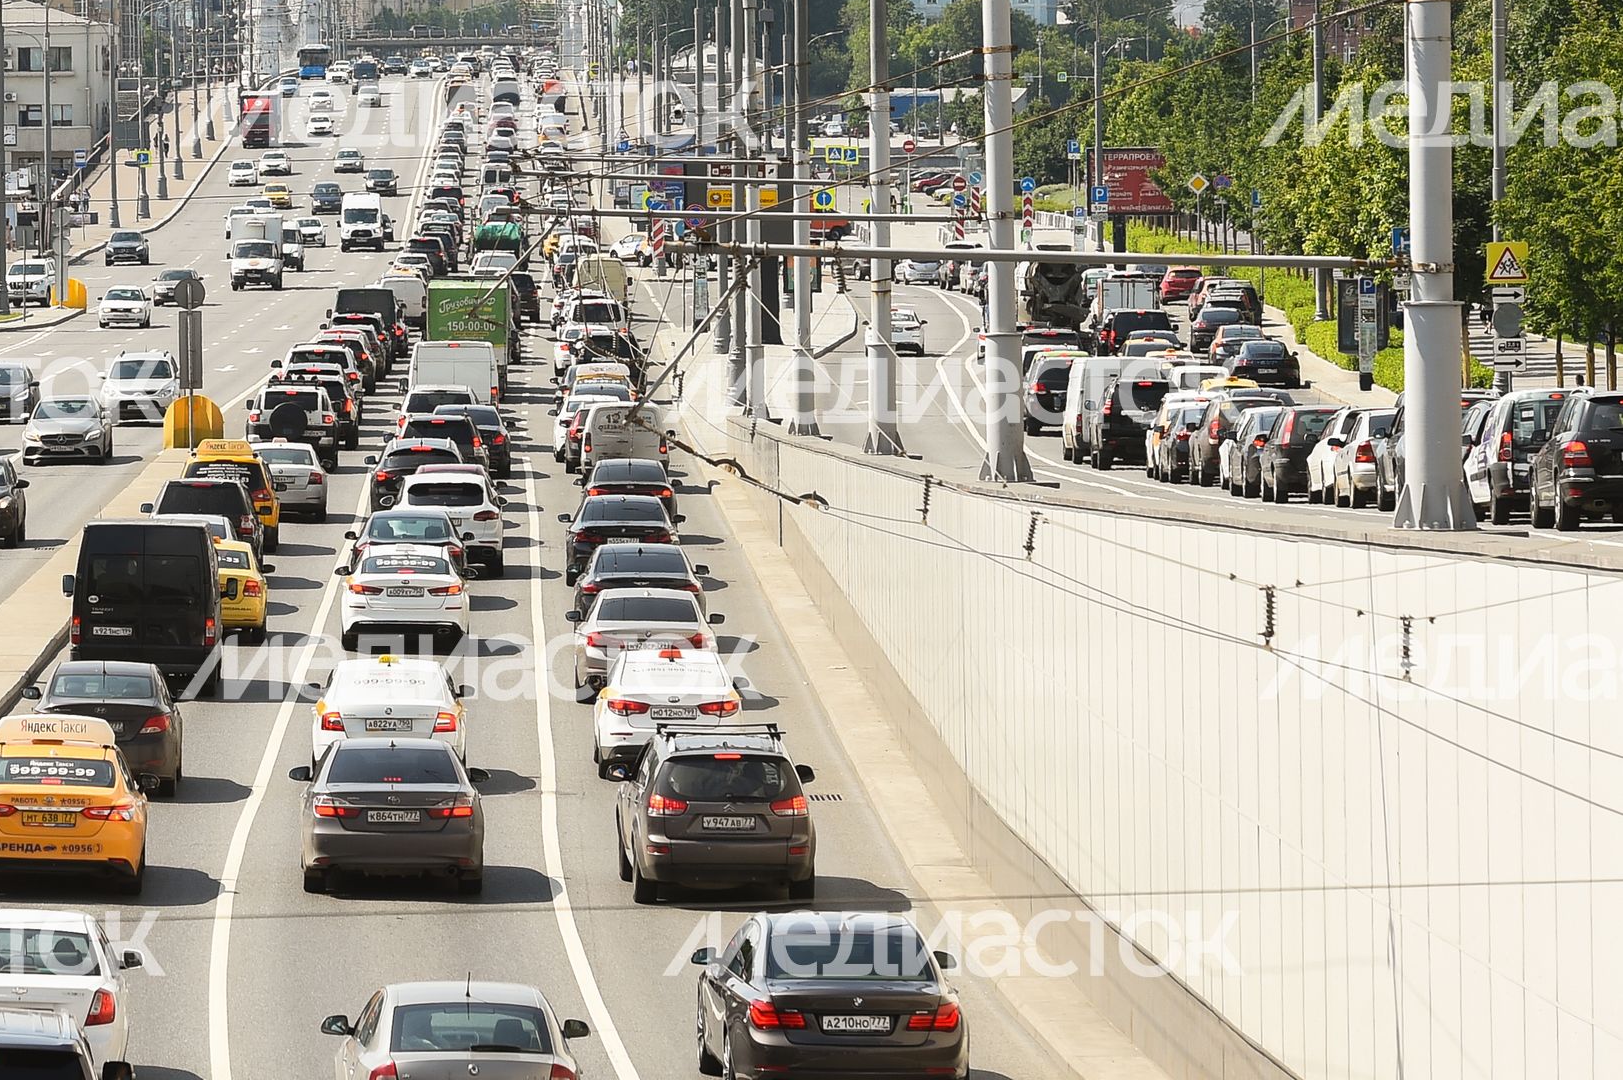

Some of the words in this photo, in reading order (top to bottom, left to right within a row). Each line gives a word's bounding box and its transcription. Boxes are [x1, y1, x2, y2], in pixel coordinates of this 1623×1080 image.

[1095, 189, 1106, 201] P
[1363, 280, 1374, 293] P
[447, 321, 496, 332] 150-00-00
[21, 720, 56, 733] Яндекс
[60, 720, 87, 733] Такси
[10, 766, 95, 777] 999-99-99
[41, 813, 58, 822] 638
[827, 1017, 869, 1028] А210НО
